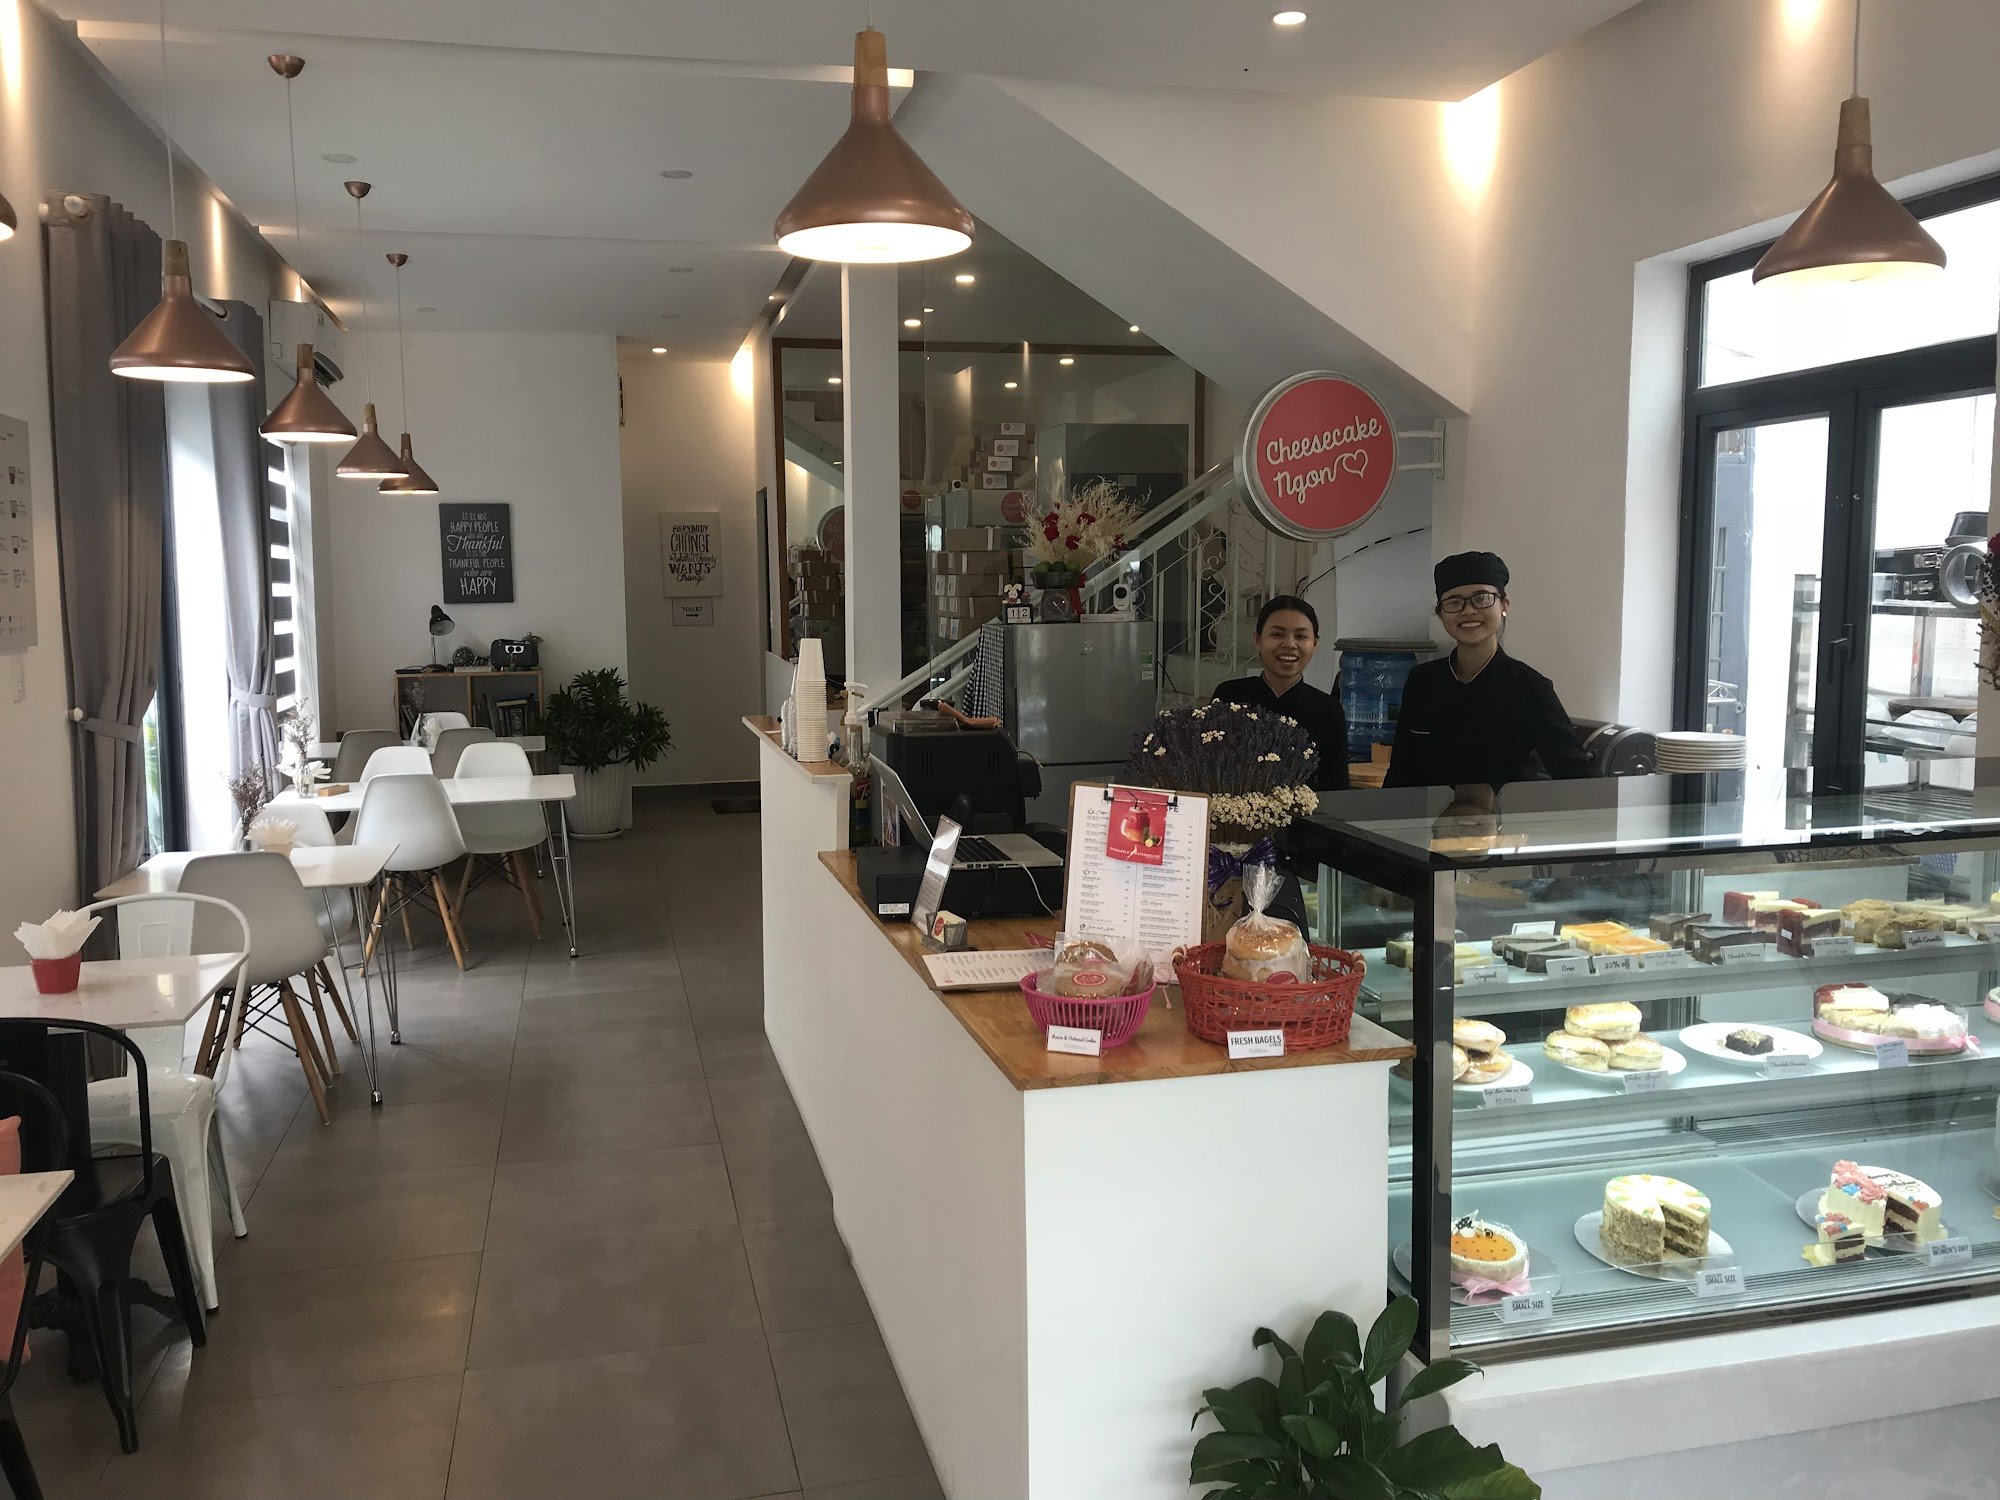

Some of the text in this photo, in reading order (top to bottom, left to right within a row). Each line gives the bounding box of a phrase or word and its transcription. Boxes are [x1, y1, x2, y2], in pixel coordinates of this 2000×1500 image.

[1266, 415, 1382, 465] Cheesecake
[1273, 463, 1339, 504] Ngon
[450, 521, 500, 533] HAPPY PEOPLE
[446, 535, 505, 552] Thankful
[449, 558, 505, 569] THANKFUL PEOPLE
[668, 562, 711, 575] WANTS
[460, 577, 497, 596] HAPPY
[1604, 960, 1620, 970] 20%
[1474, 970, 1498, 982] Original
[1230, 1034, 1282, 1046] FRESH BAGELS
[1705, 1276, 1724, 1286] SMALL
[1724, 1274, 1737, 1283] SIZE
[1512, 1300, 1531, 1311] SMALL
[1532, 1299, 1545, 1309] SIZE
